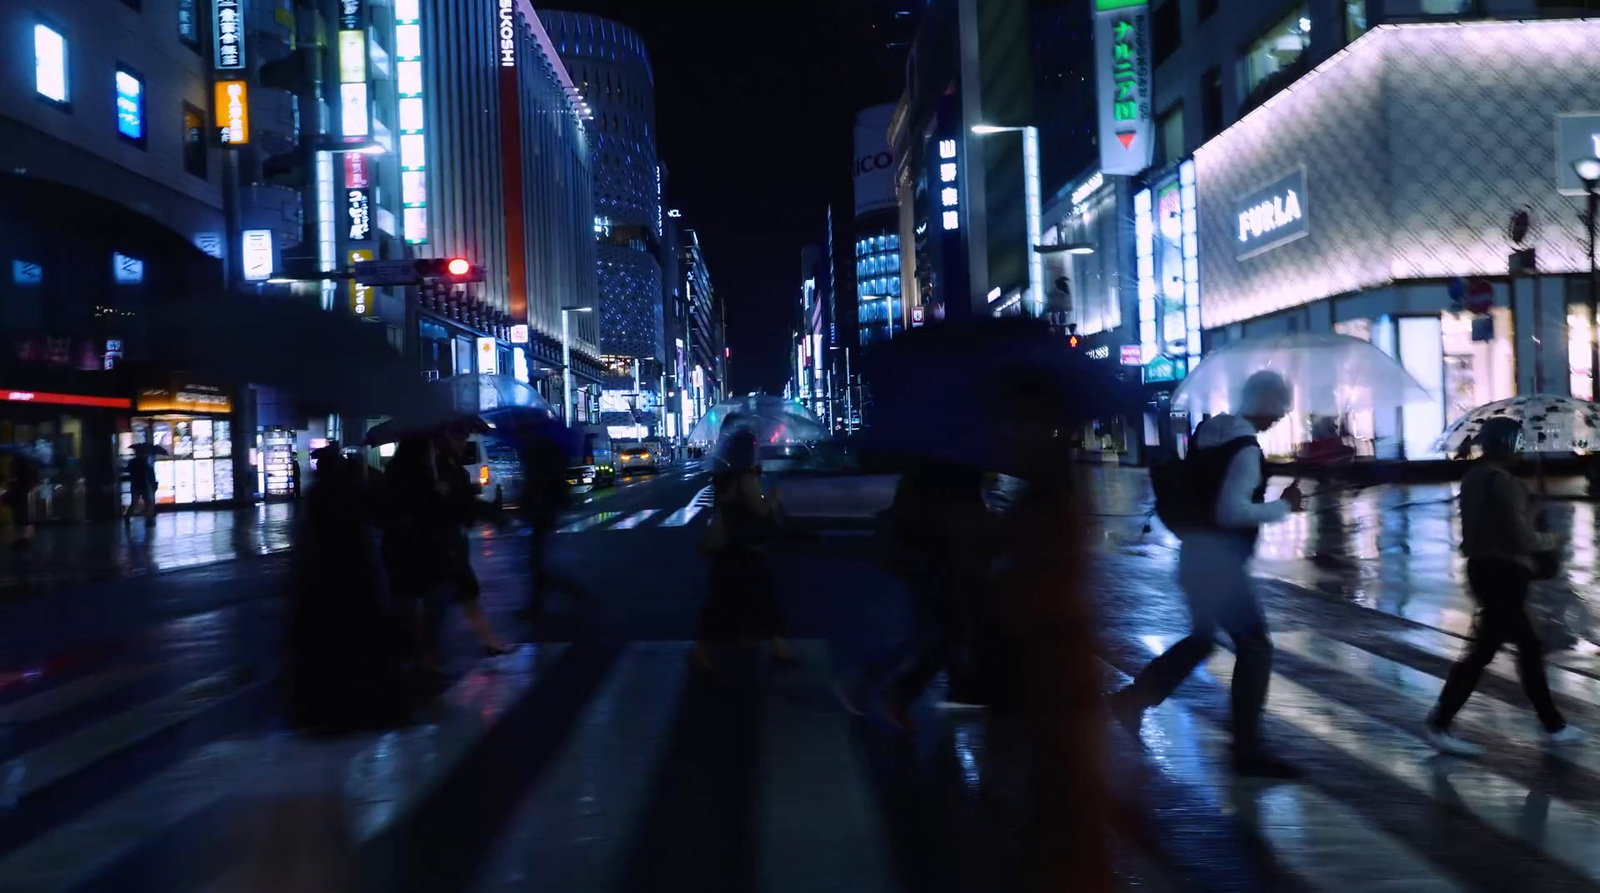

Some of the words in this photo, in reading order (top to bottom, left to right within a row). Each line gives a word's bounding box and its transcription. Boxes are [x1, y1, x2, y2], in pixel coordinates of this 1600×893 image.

[1113, 20, 1137, 121] ナルニア国
[1238, 189, 1302, 242] FURLA
